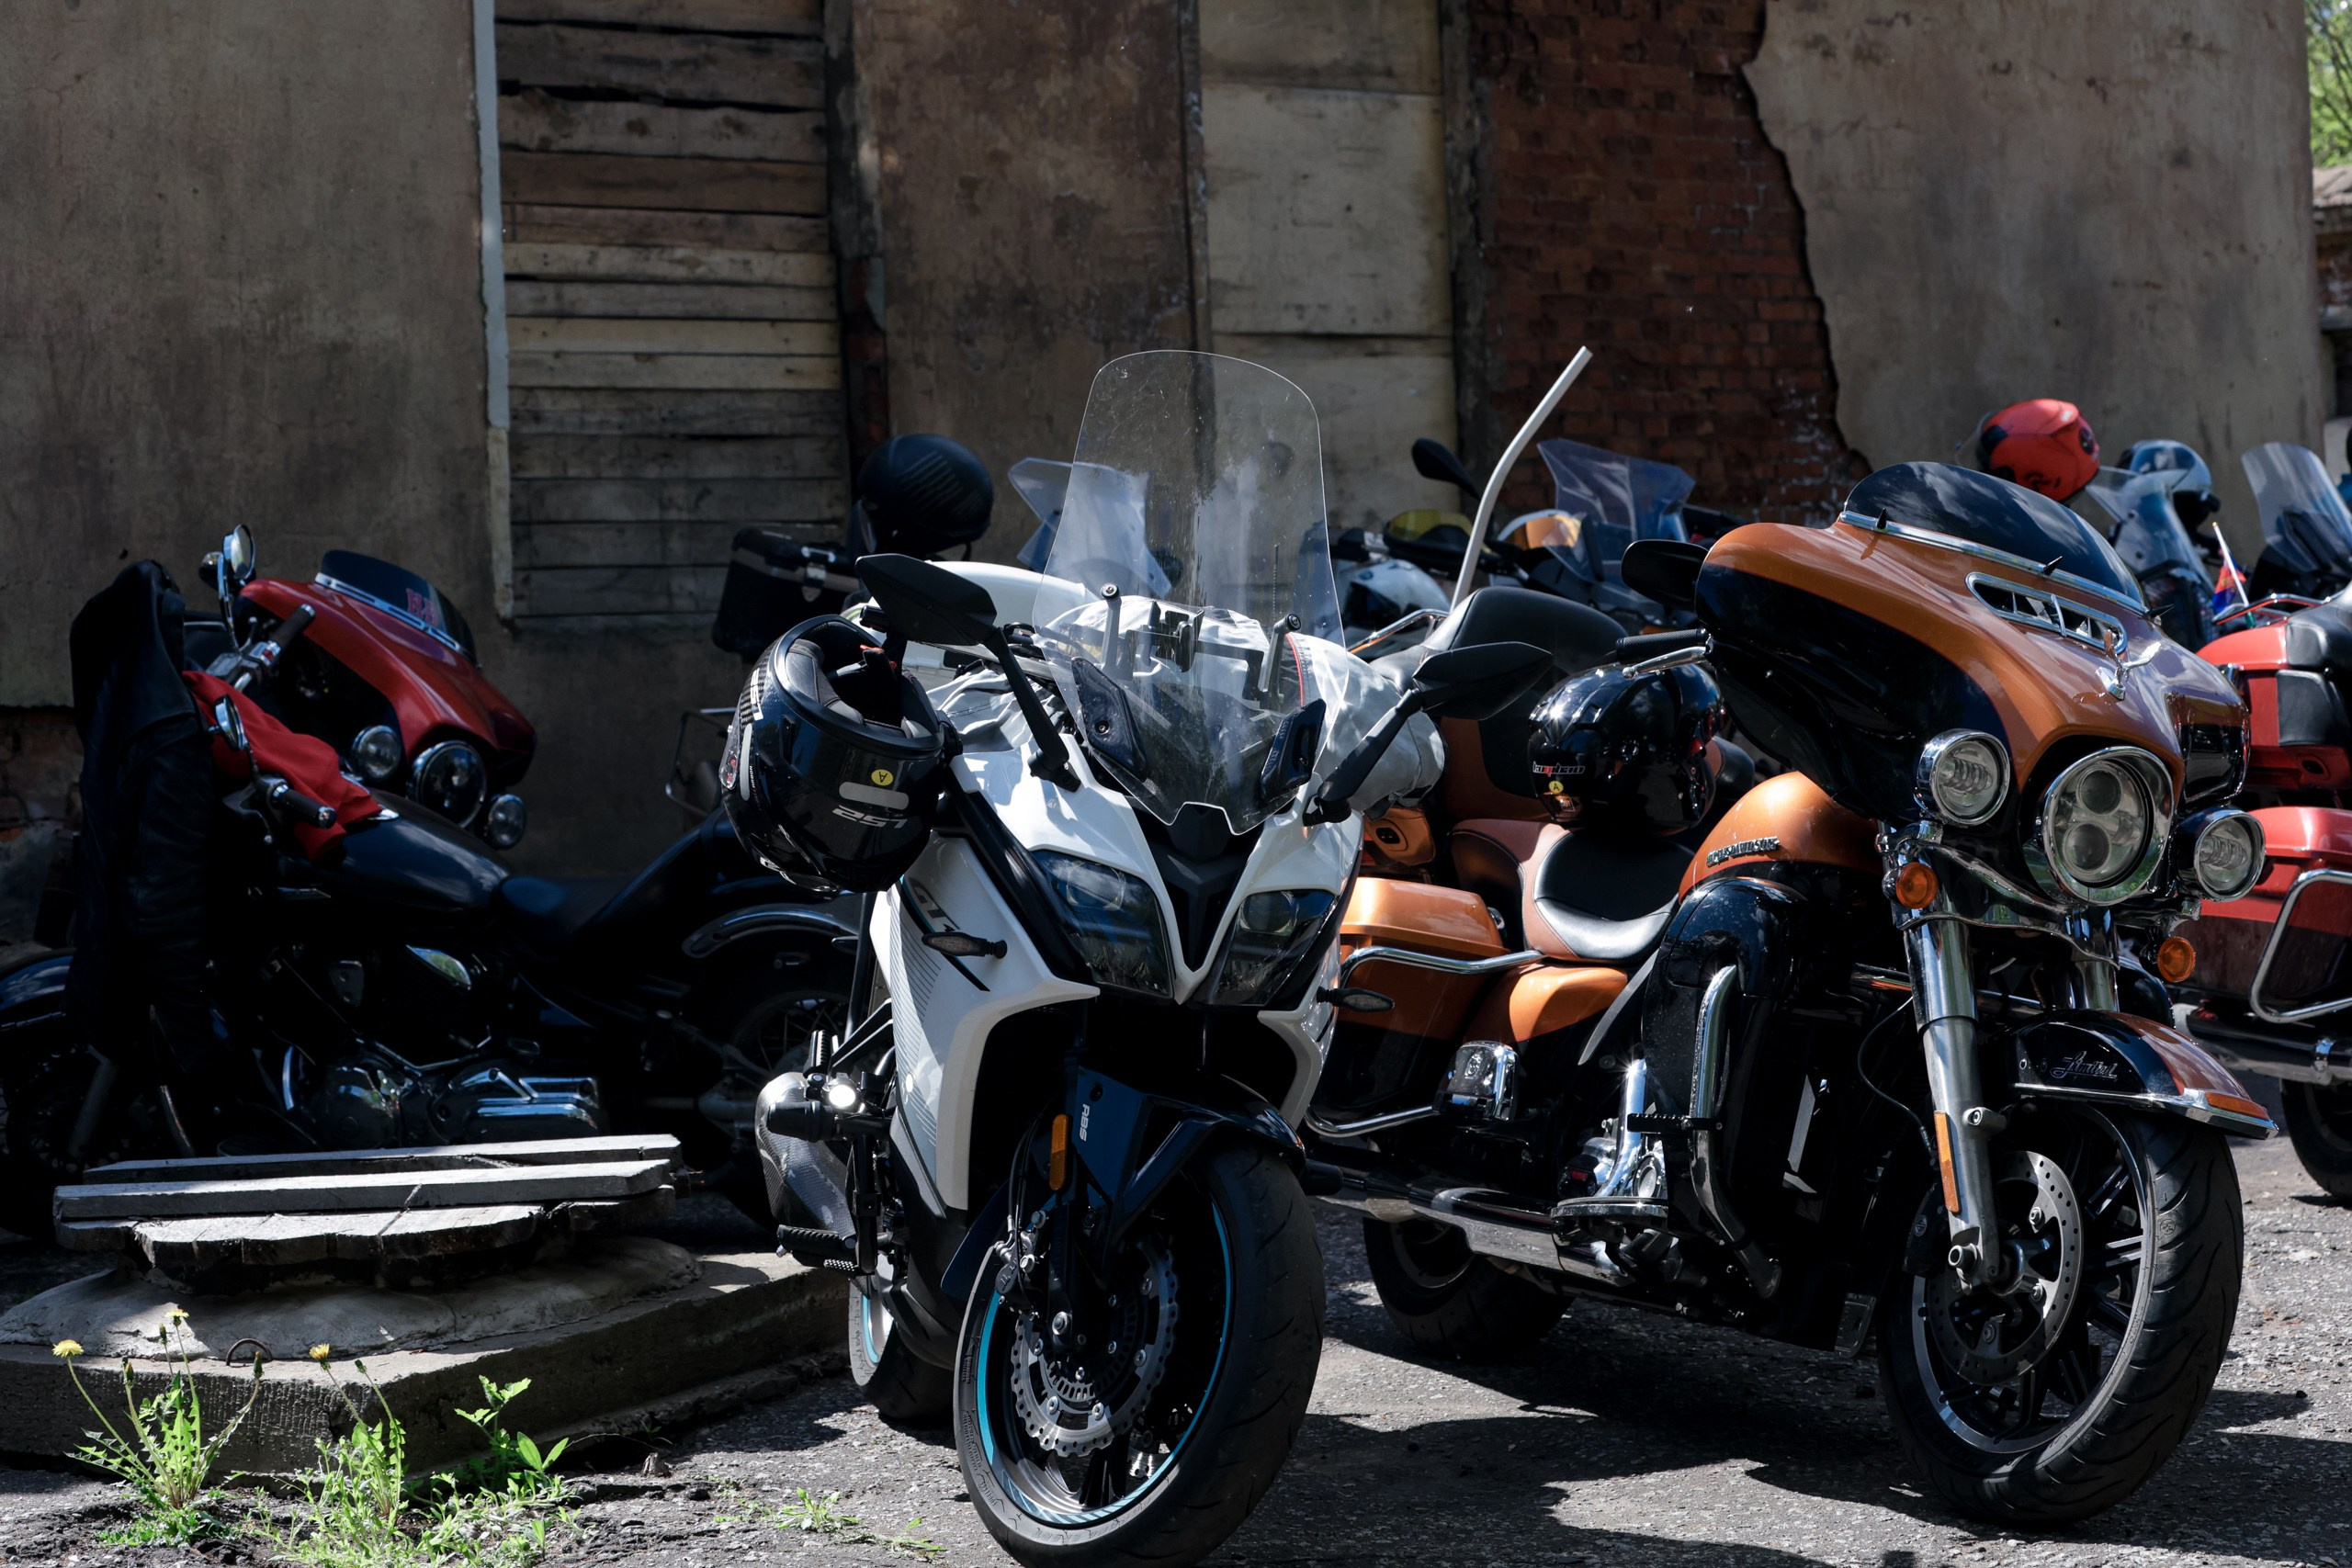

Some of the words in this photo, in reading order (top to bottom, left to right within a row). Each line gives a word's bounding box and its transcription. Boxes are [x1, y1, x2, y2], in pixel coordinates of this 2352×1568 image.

[832, 804, 909, 829] LS2
[2050, 1051, 2119, 1081] Limited
[1079, 1103, 1091, 1142] ABS
